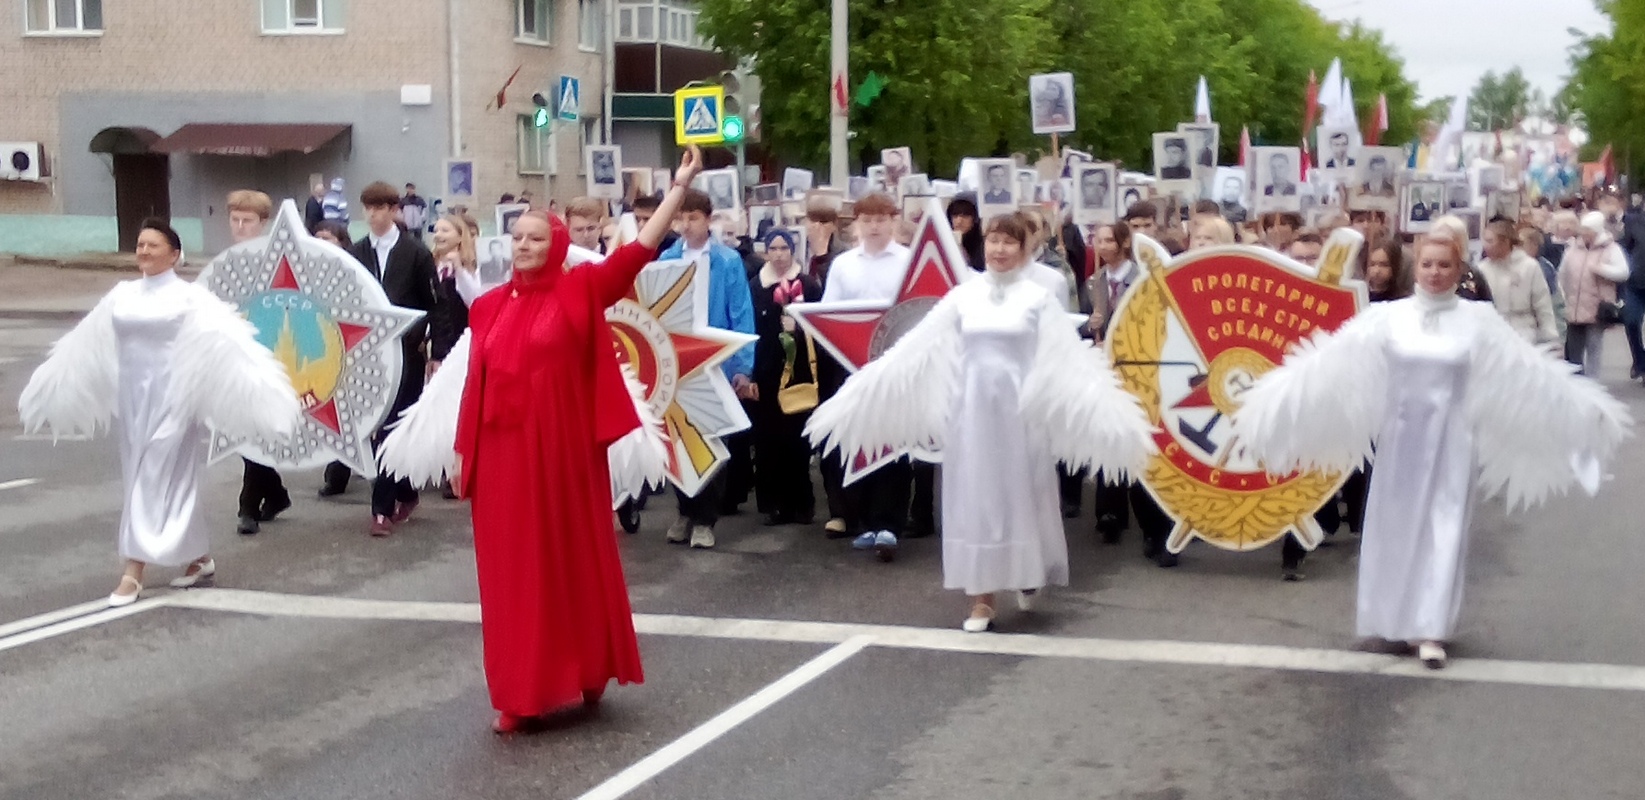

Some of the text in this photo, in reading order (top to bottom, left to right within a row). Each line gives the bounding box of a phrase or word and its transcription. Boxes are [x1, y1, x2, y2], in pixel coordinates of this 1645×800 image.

[262, 293, 313, 311] СССР
[1191, 271, 1330, 317] ПРОЛЕТАРИИ
[1210, 296, 1321, 333] ВСЕХ СТР
